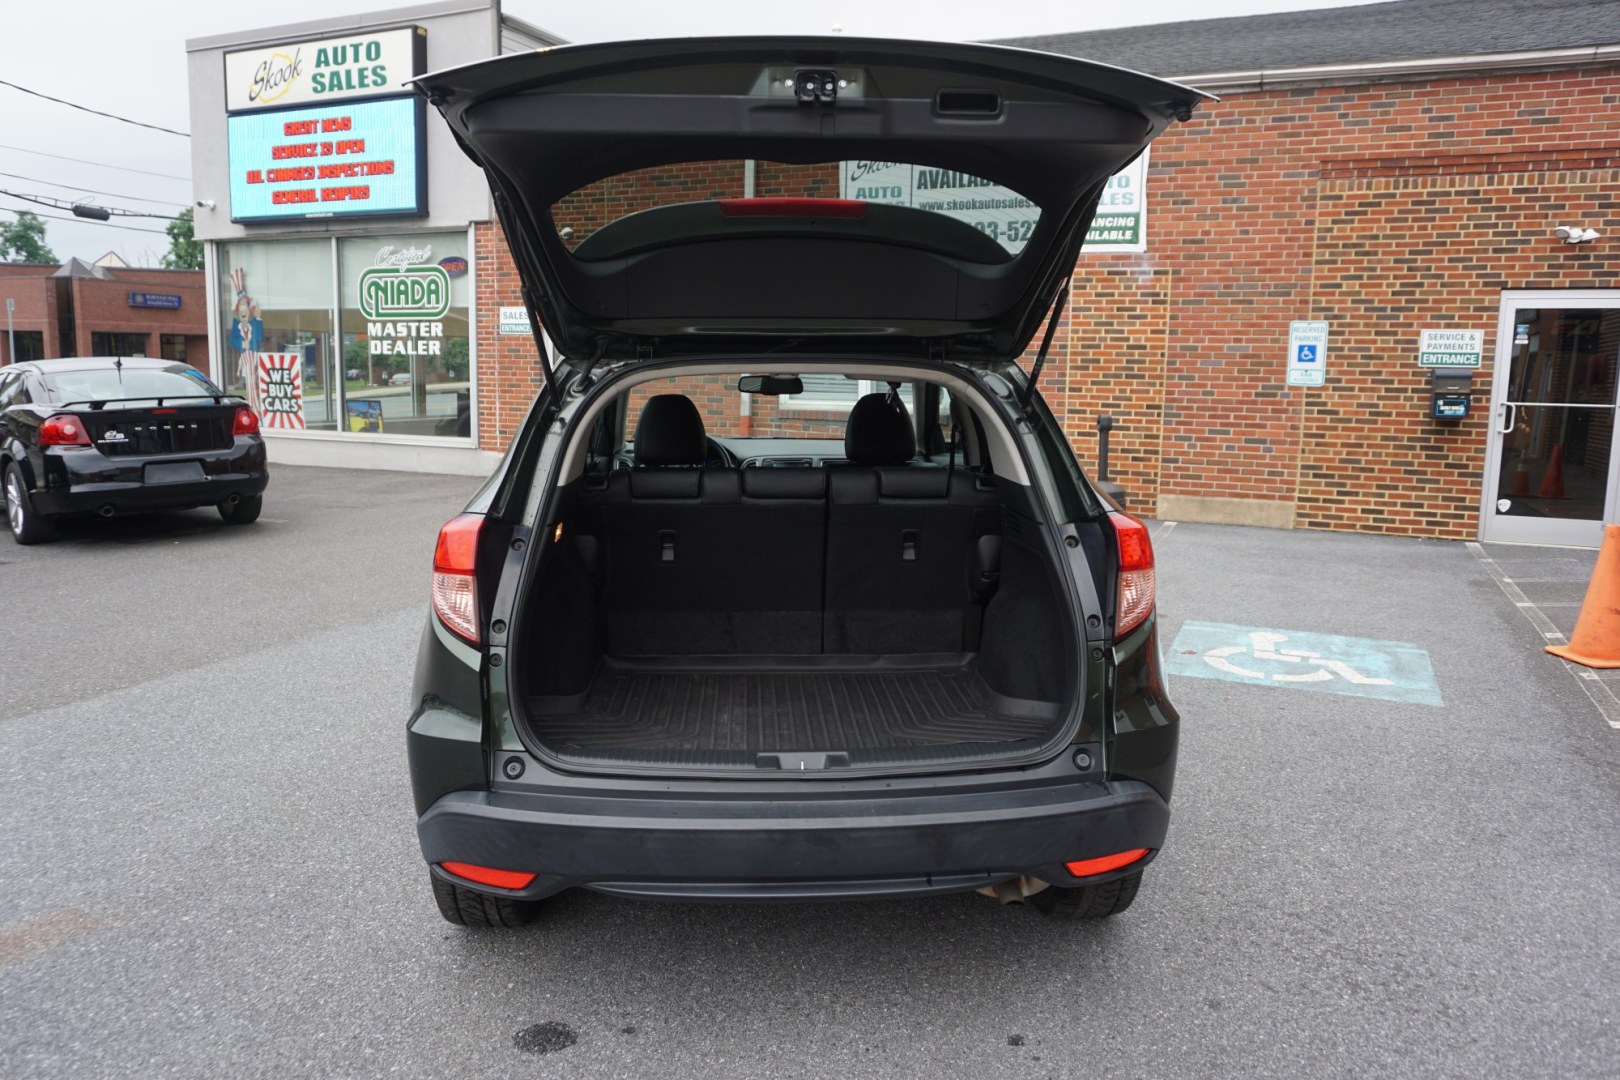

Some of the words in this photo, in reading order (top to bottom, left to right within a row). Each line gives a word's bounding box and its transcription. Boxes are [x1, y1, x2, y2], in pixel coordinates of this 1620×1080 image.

[315, 41, 381, 68] AUTO
[249, 48, 303, 101] Skook
[311, 65, 387, 94] SALES
[284, 120, 319, 136] GREAT
[321, 116, 352, 133] NEWS
[272, 143, 318, 160] SERVICE
[320, 141, 333, 156] IS
[335, 138, 365, 155] OPEN
[246, 170, 264, 184] OIL
[266, 165, 315, 182] CHANGES
[317, 159, 394, 179] INSPECTIONS
[272, 188, 318, 204] GENERAL
[856, 186, 902, 199] AUTO
[375, 244, 432, 273] Certified
[366, 276, 441, 307] NIADA
[367, 322, 443, 337] MASTER
[1427, 333, 1466, 341] SERVICE
[1469, 333, 1476, 341] &
[370, 340, 441, 355] DEALER
[1422, 353, 1478, 364] ENTRANCE
[269, 369, 291, 383] WE
[268, 383, 294, 398] BUY
[264, 398, 299, 412] CARS
